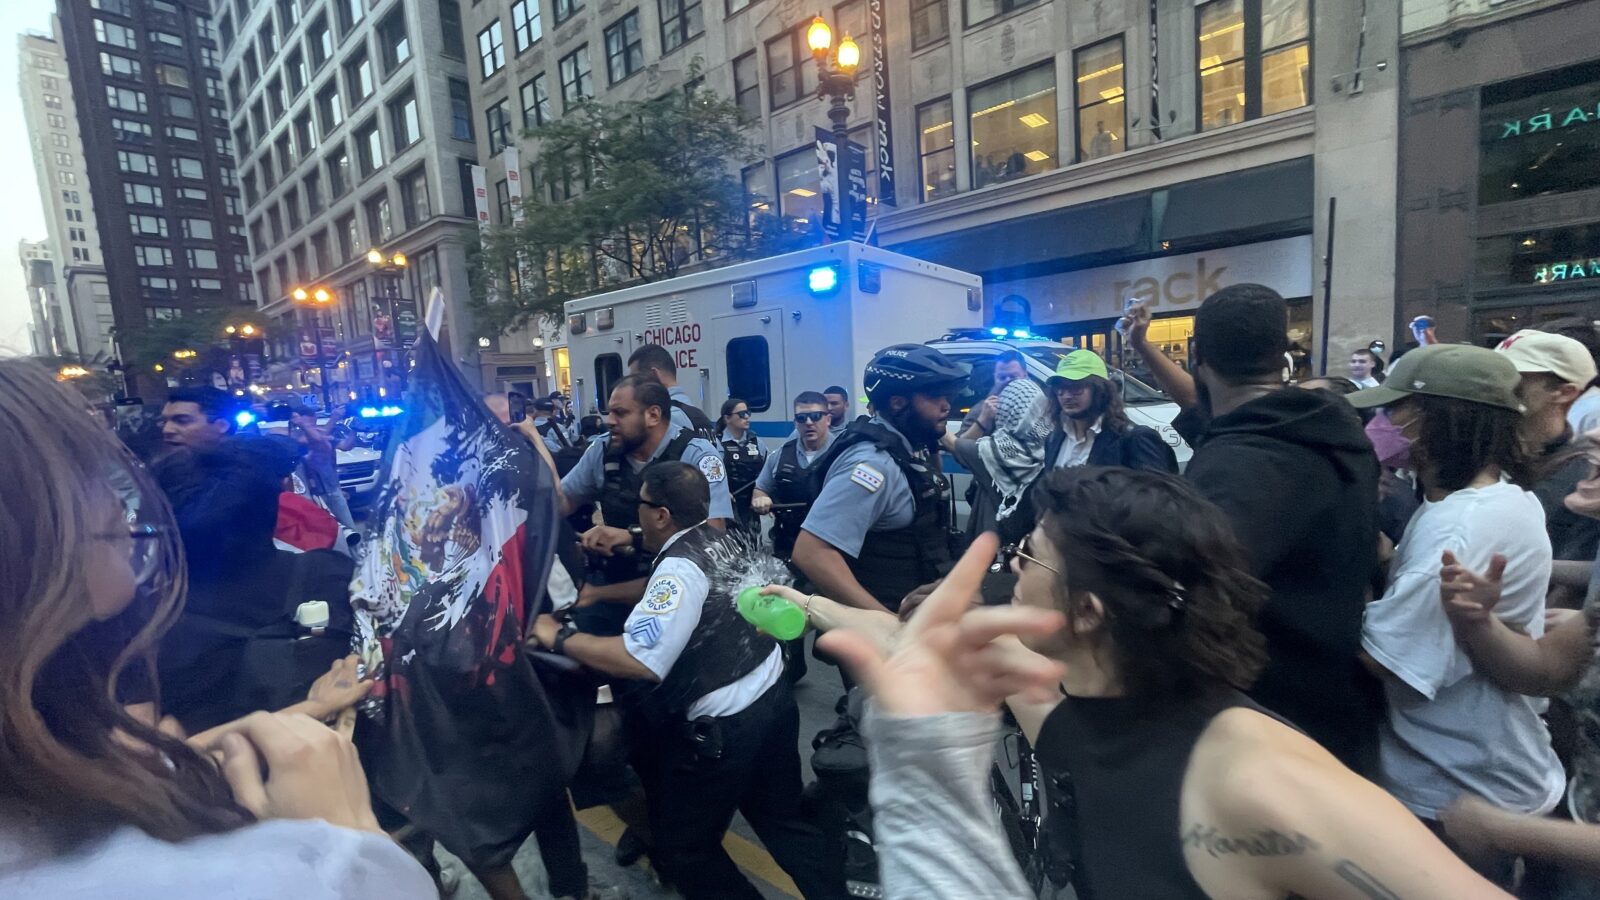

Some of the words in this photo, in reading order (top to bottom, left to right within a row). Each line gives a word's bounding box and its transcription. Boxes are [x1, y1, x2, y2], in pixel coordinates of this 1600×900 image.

[879, 118, 893, 181] rack
[1112, 257, 1227, 312] rack
[644, 323, 701, 346] CHICAGO
[675, 349, 698, 369] ICE
[884, 350, 909, 358] POLICE
[649, 579, 678, 595] CHICAGO
[646, 599, 673, 611] POLICE
